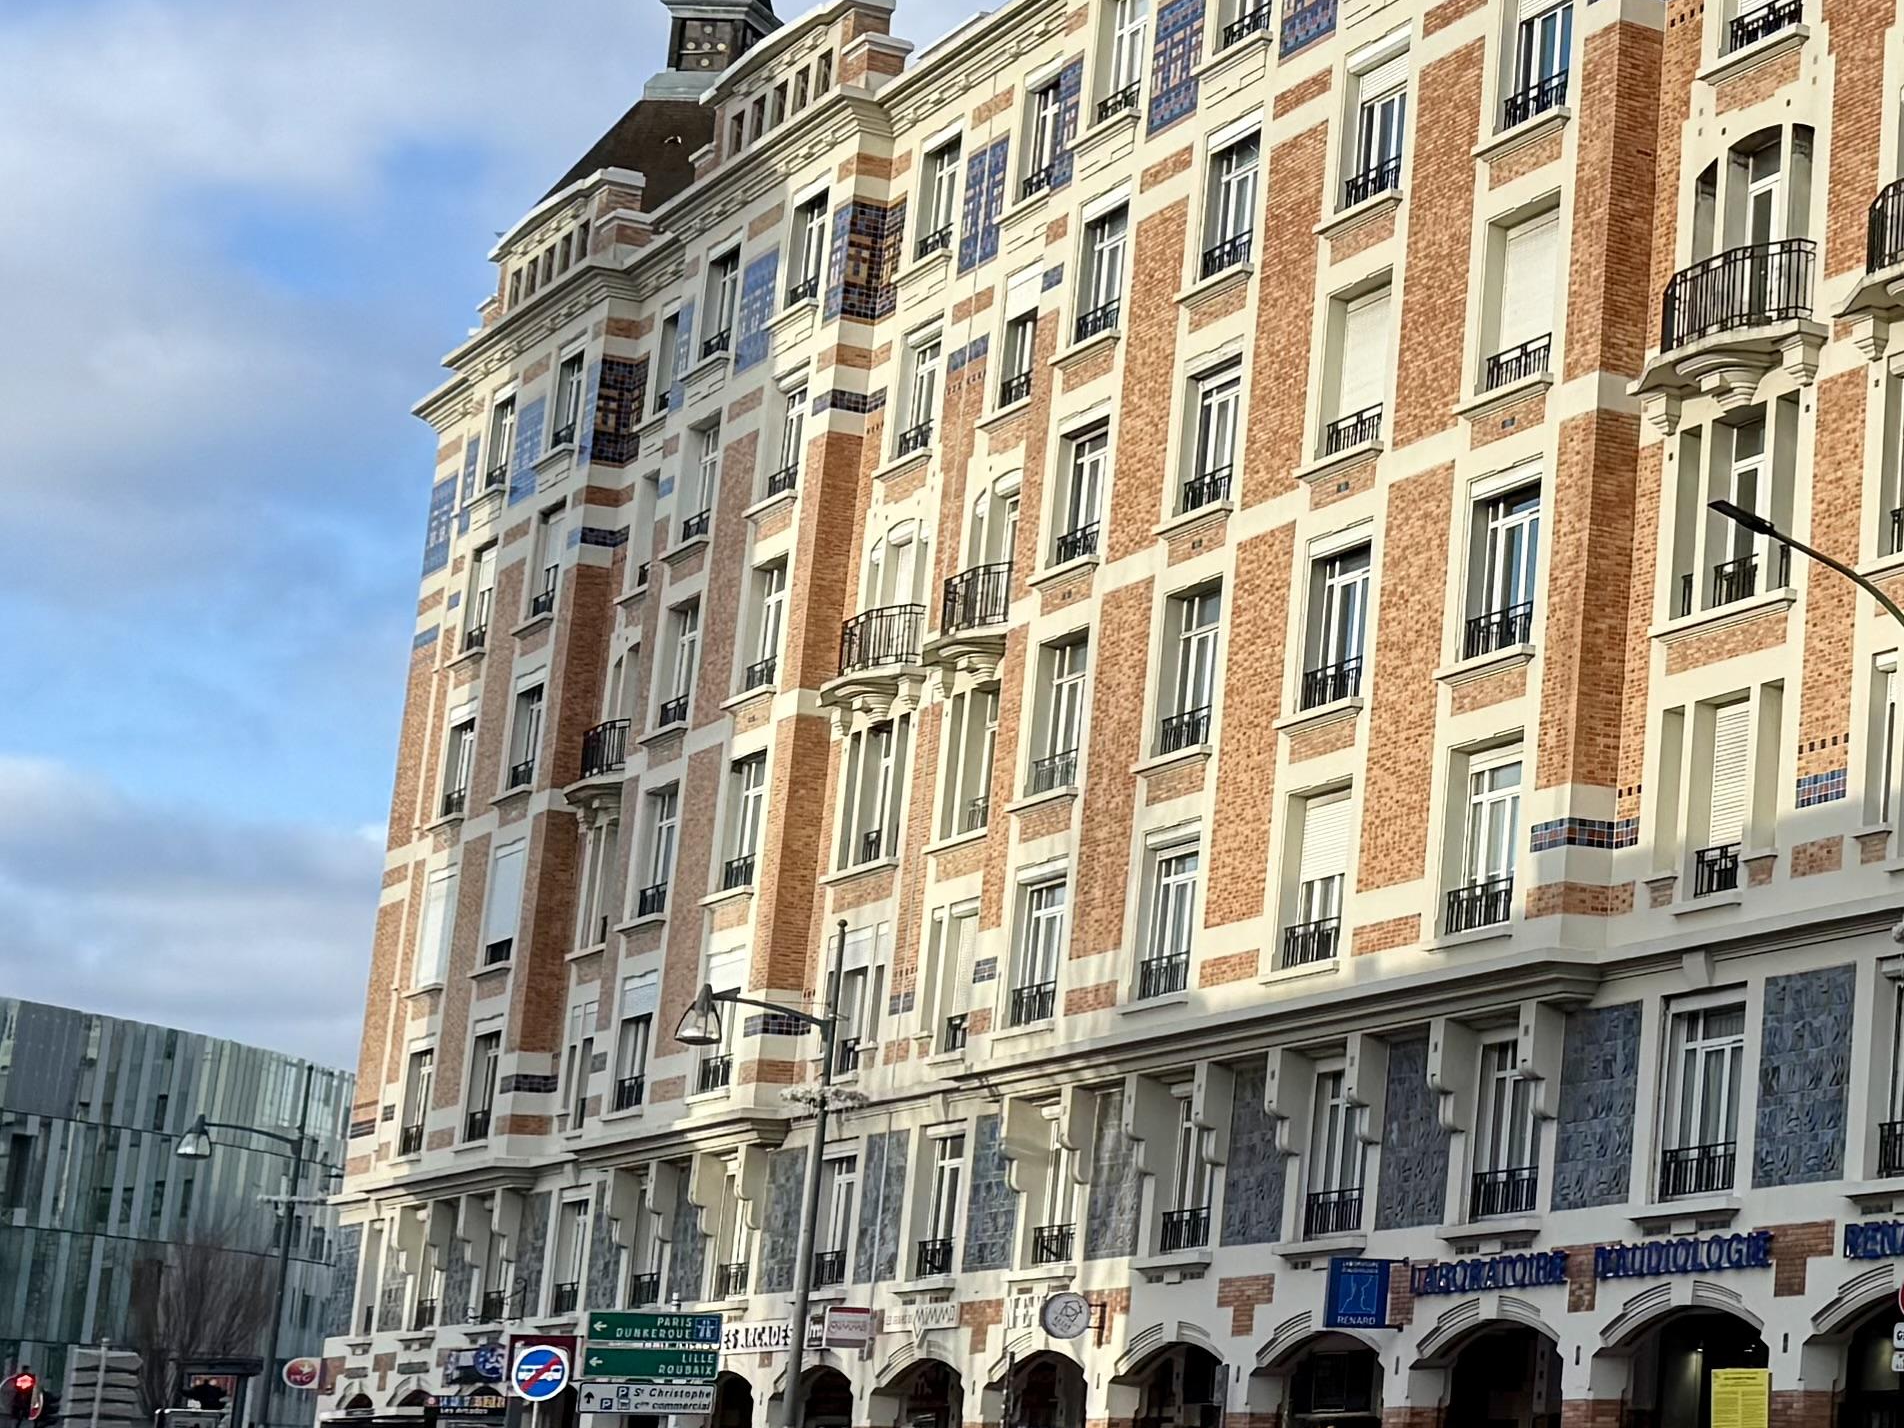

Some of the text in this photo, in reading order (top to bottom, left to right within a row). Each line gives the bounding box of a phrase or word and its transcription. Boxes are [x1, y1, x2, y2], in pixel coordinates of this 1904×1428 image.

[1410, 1250, 1569, 1295] LABORATOIRE
[1595, 1230, 1775, 1279] D'AUDIOLOGIE
[657, 1317, 692, 1327] PARIS
[1337, 1316, 1376, 1325] RENARD
[616, 1328, 692, 1339] DUNKERQUE
[682, 1354, 714, 1363] LILLE
[658, 1364, 713, 1375] ROUBAIX
[649, 1386, 712, 1400] Christophe
[652, 1399, 711, 1411] commercial
